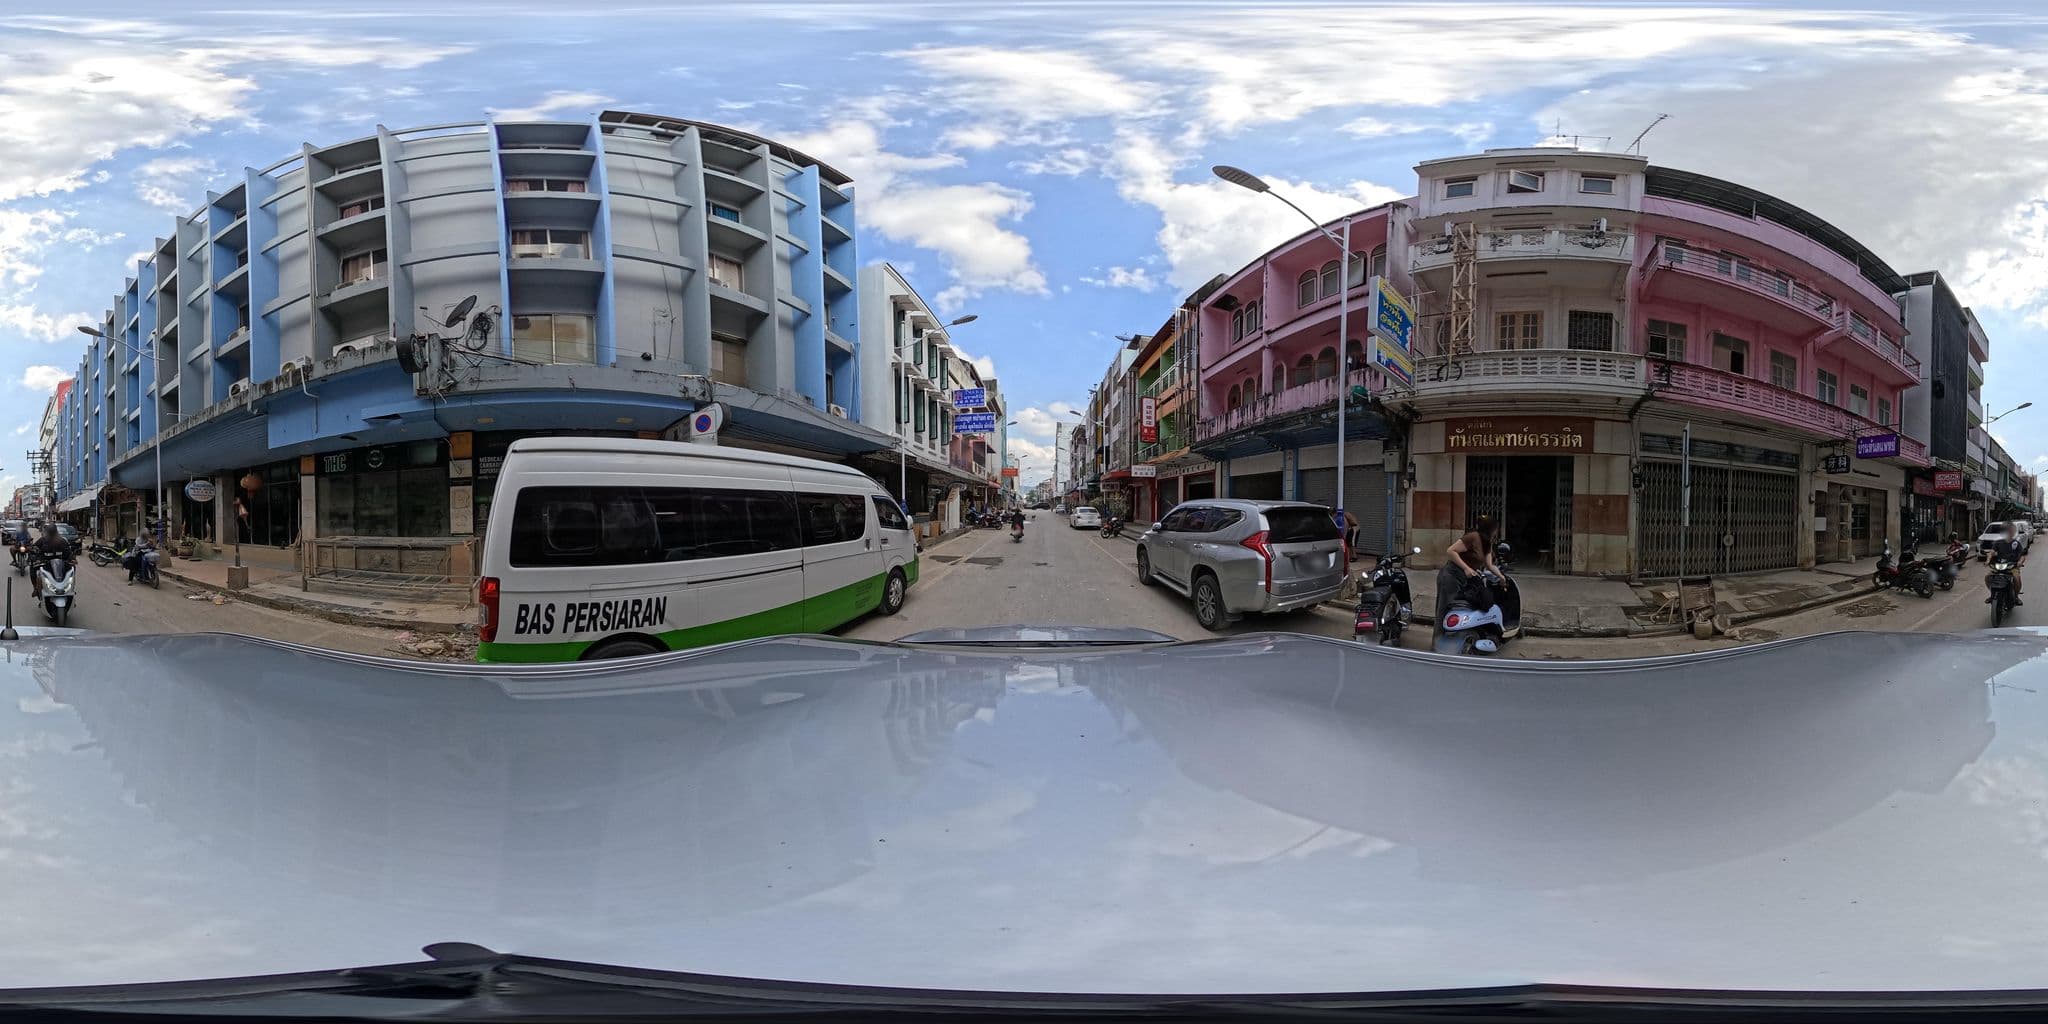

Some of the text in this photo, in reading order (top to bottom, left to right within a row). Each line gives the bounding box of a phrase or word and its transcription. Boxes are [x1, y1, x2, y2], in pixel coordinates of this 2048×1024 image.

[323, 454, 347, 473] THC
[515, 596, 667, 635] BAS PERSIARAN
